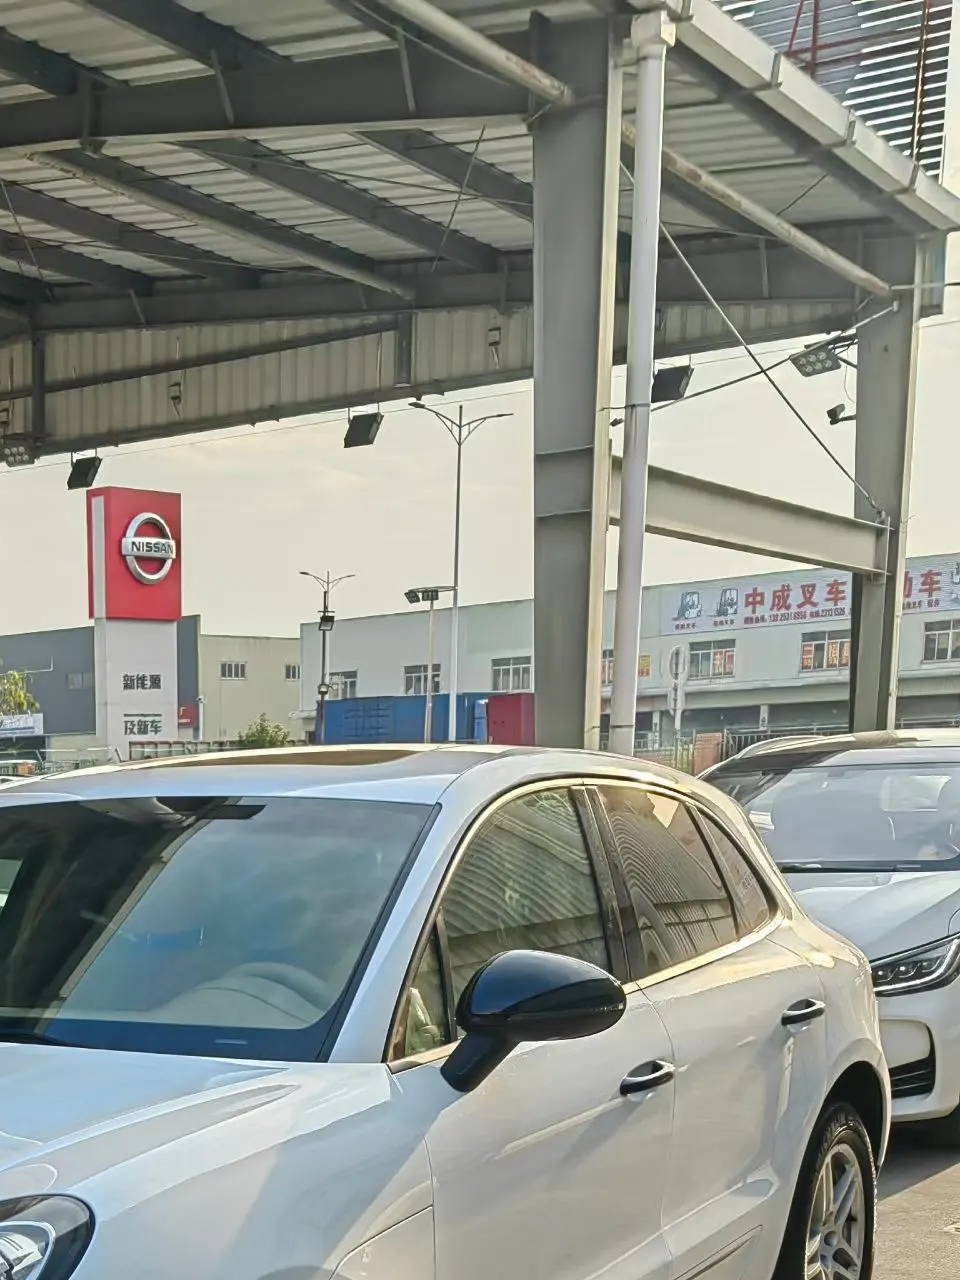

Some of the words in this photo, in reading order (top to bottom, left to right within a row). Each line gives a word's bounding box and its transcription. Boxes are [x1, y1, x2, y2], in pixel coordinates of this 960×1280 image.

[131, 540, 174, 555] NISSAN
[744, 578, 847, 615] 中成叉车
[904, 569, 942, 598] 车
[123, 673, 162, 691] 新能源
[123, 719, 162, 736] 及新车
